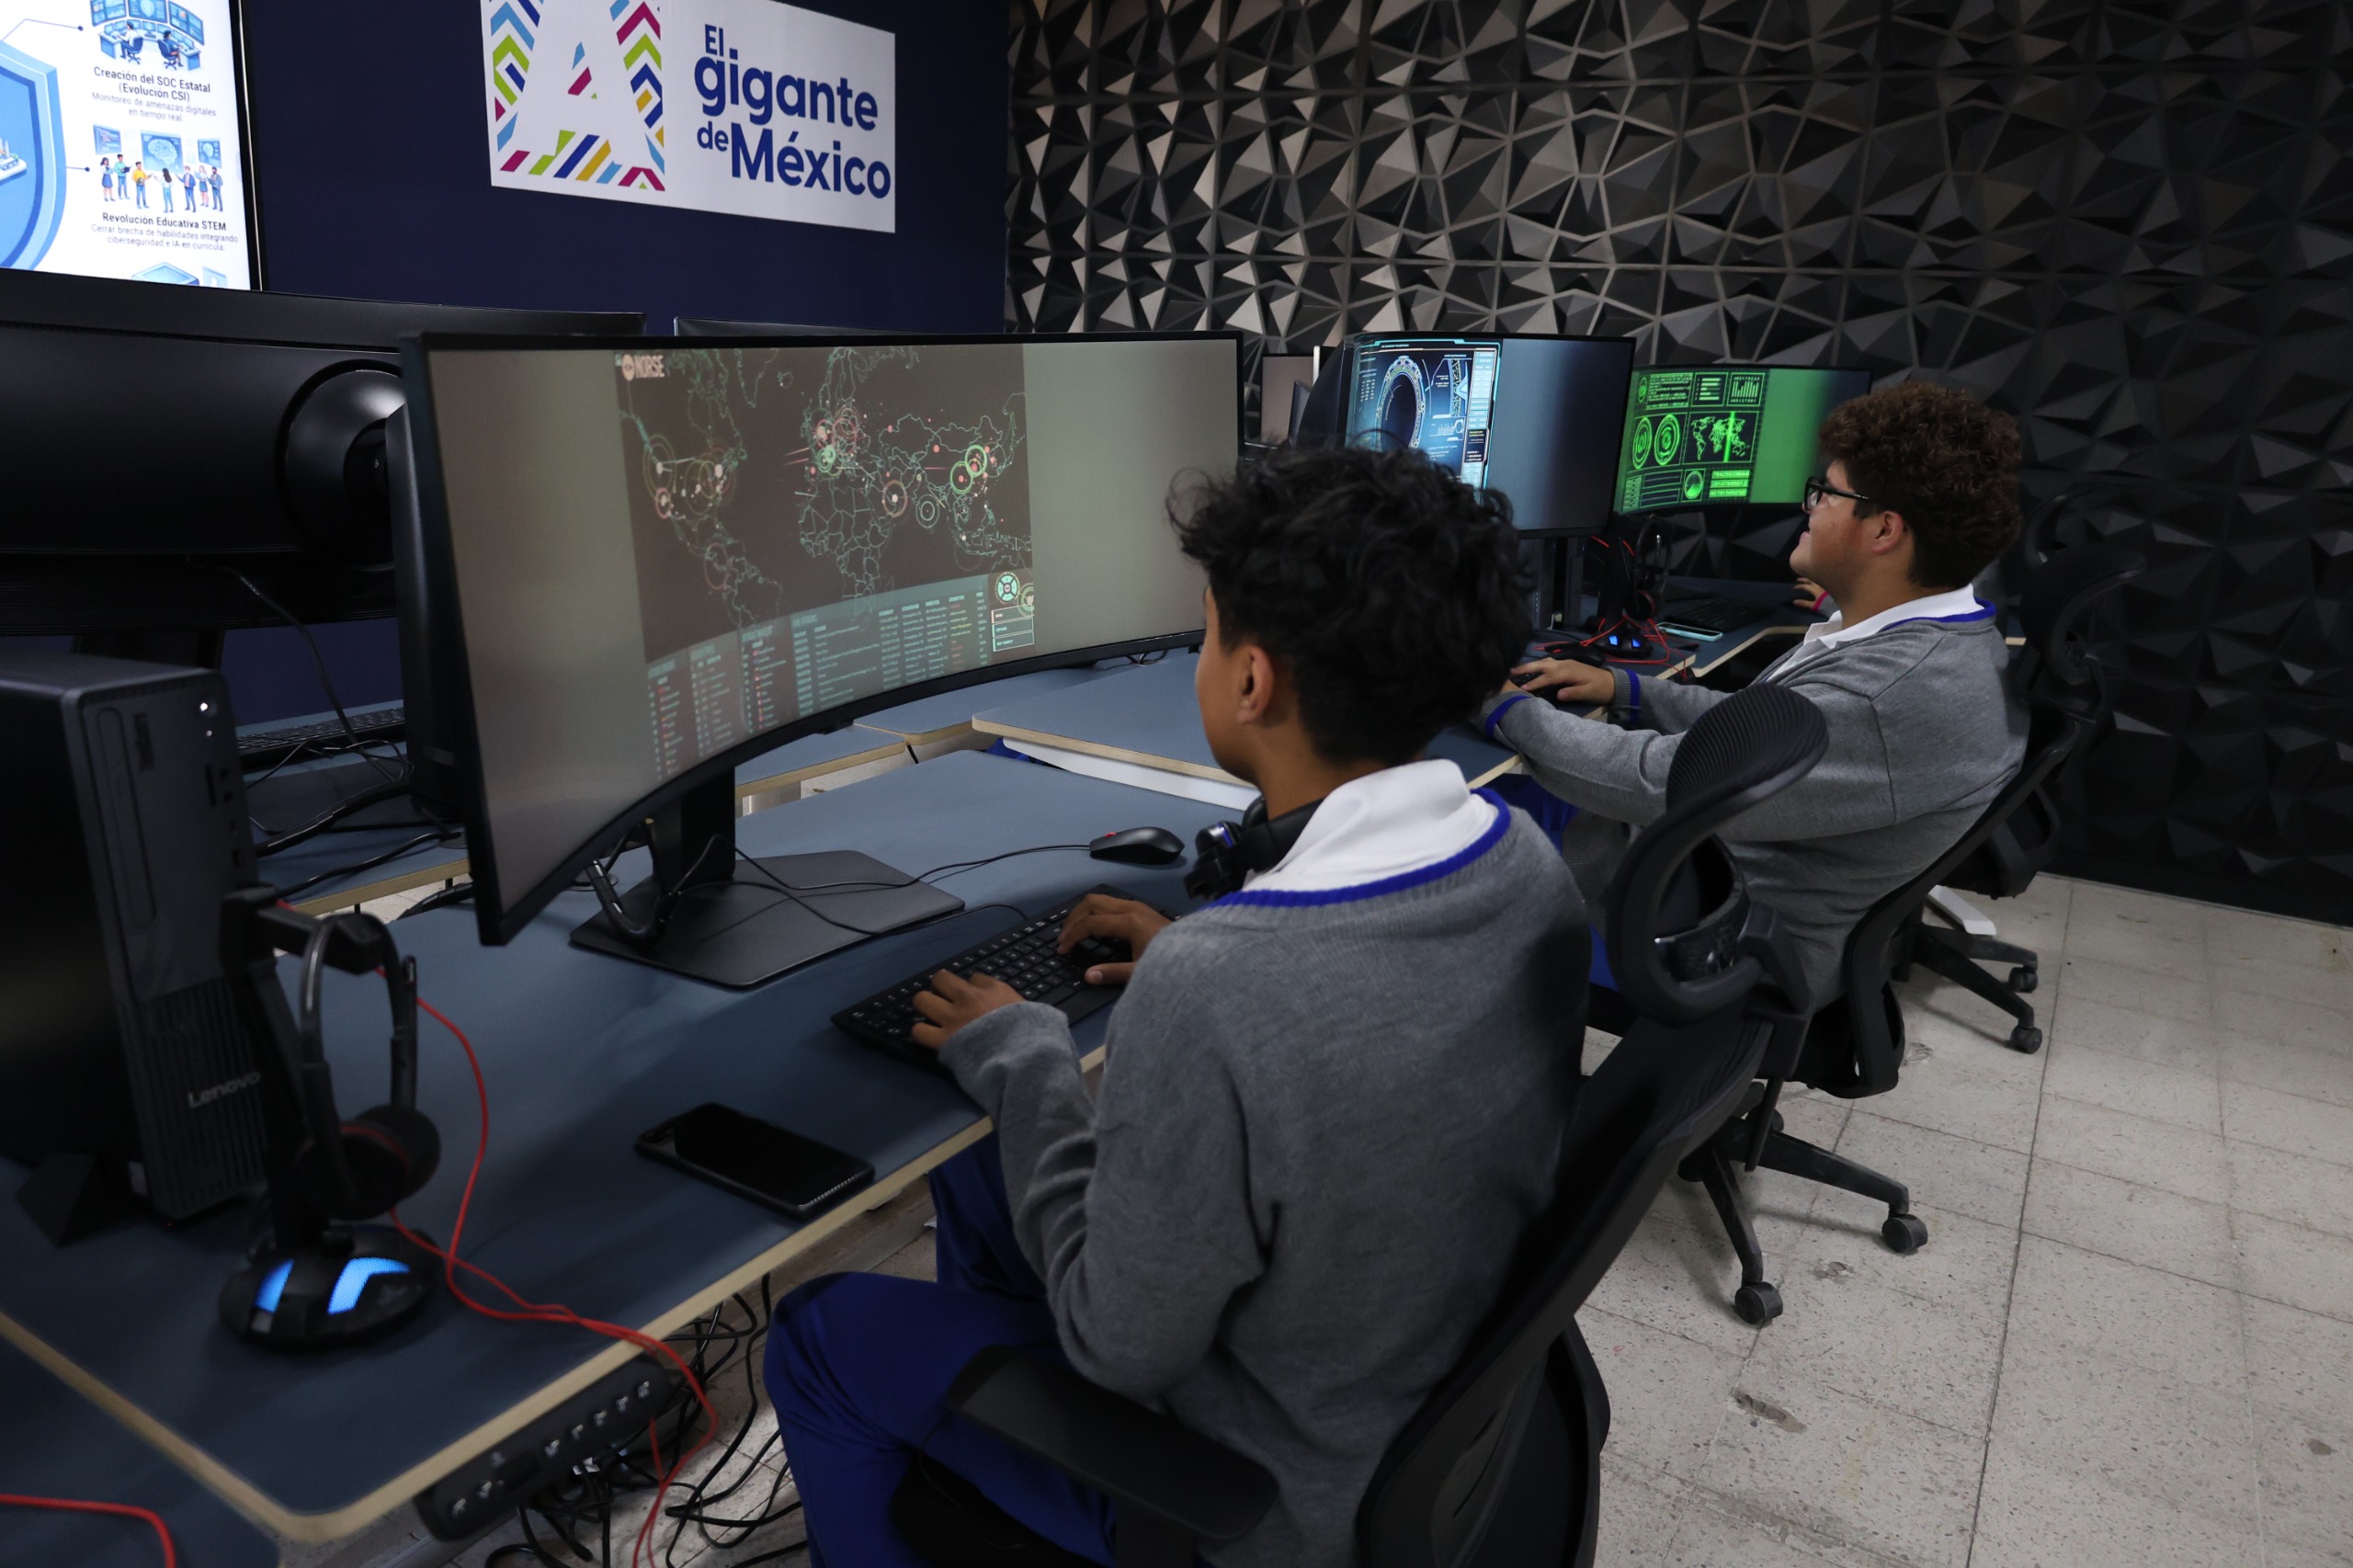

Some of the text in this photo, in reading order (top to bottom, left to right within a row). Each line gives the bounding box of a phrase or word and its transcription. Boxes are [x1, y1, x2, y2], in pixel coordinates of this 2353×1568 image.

[705, 24, 723, 56] El
[94, 66, 210, 93] Creación del SOC Estatal
[694, 48, 879, 131] gigante
[92, 92, 217, 117] Monitoreo de amenazas digitales
[119, 83, 190, 103] (Evolución CSI)
[140, 109, 165, 120] tiempo
[697, 121, 891, 199] de México
[91, 223, 115, 233] Cerrar
[118, 226, 143, 235] brecha
[157, 229, 199, 240] habilidades
[200, 233, 238, 243] integrando
[102, 212, 227, 231] Revolución Educativa STEM
[107, 235, 164, 246] ciberseguridad
[188, 1072, 261, 1108] Lenovo
